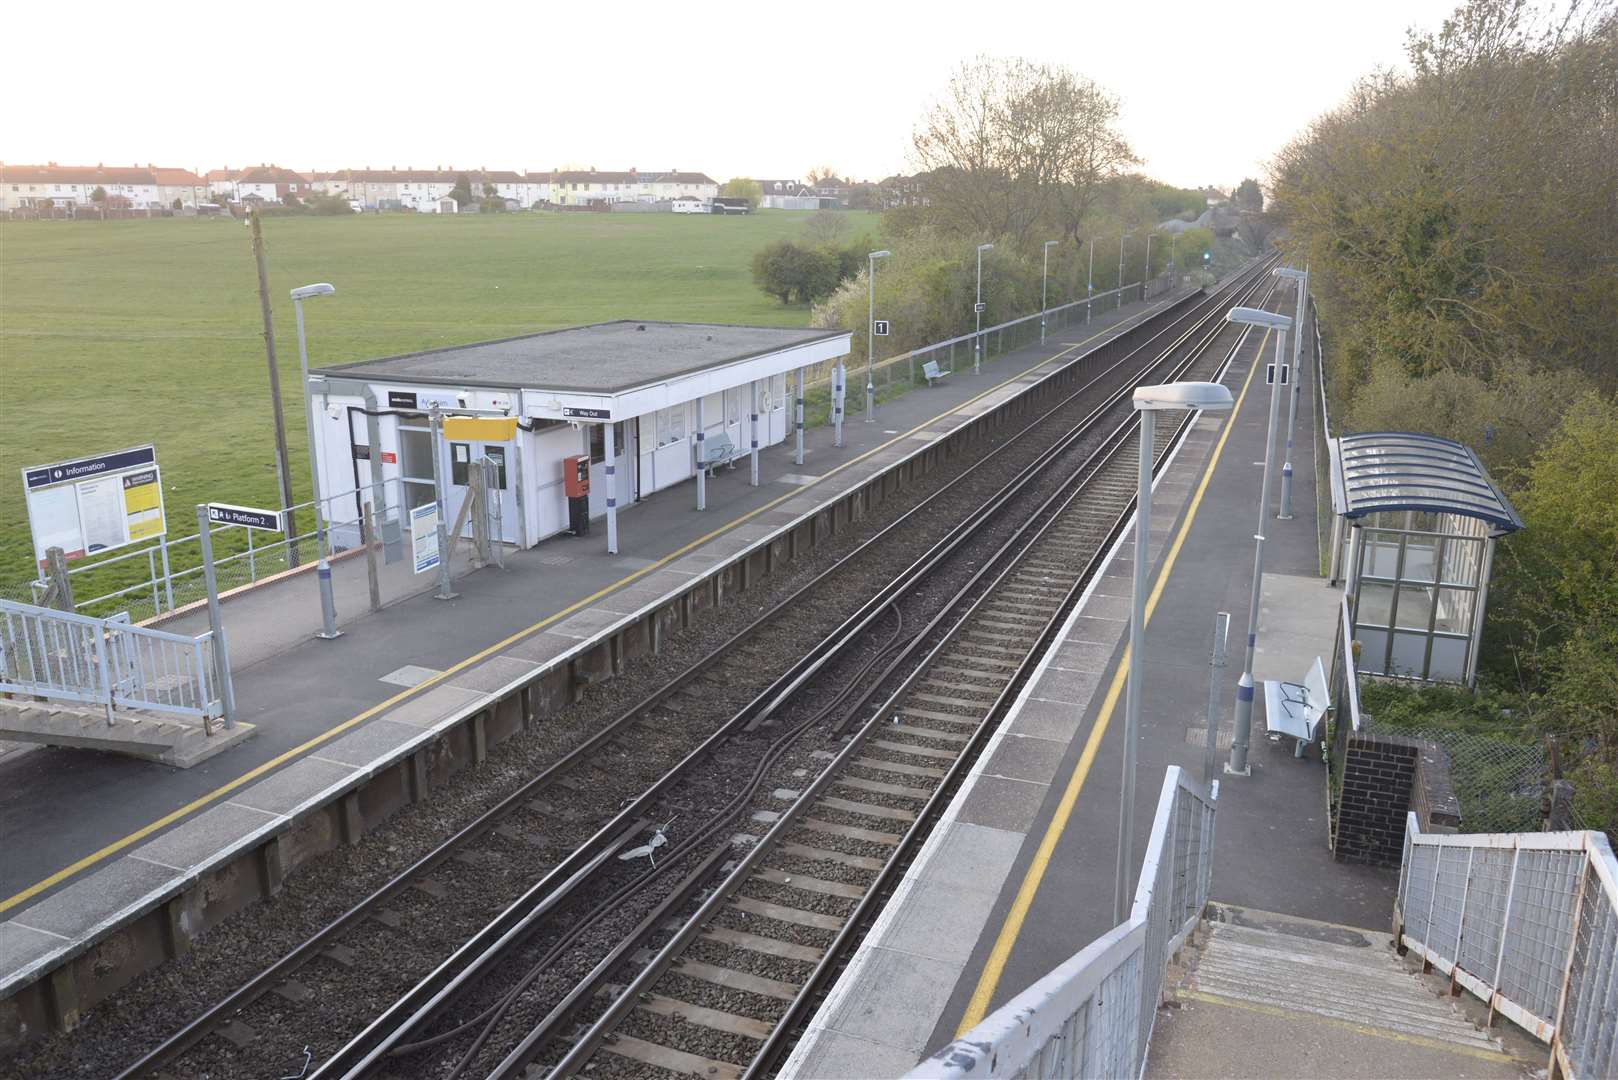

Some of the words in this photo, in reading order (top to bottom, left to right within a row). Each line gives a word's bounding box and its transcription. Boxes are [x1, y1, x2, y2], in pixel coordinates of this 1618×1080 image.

[877, 323, 883, 333] 1
[66, 462, 106, 476] Information
[232, 513, 260, 525] Platform
[260, 517, 265, 525] 2
